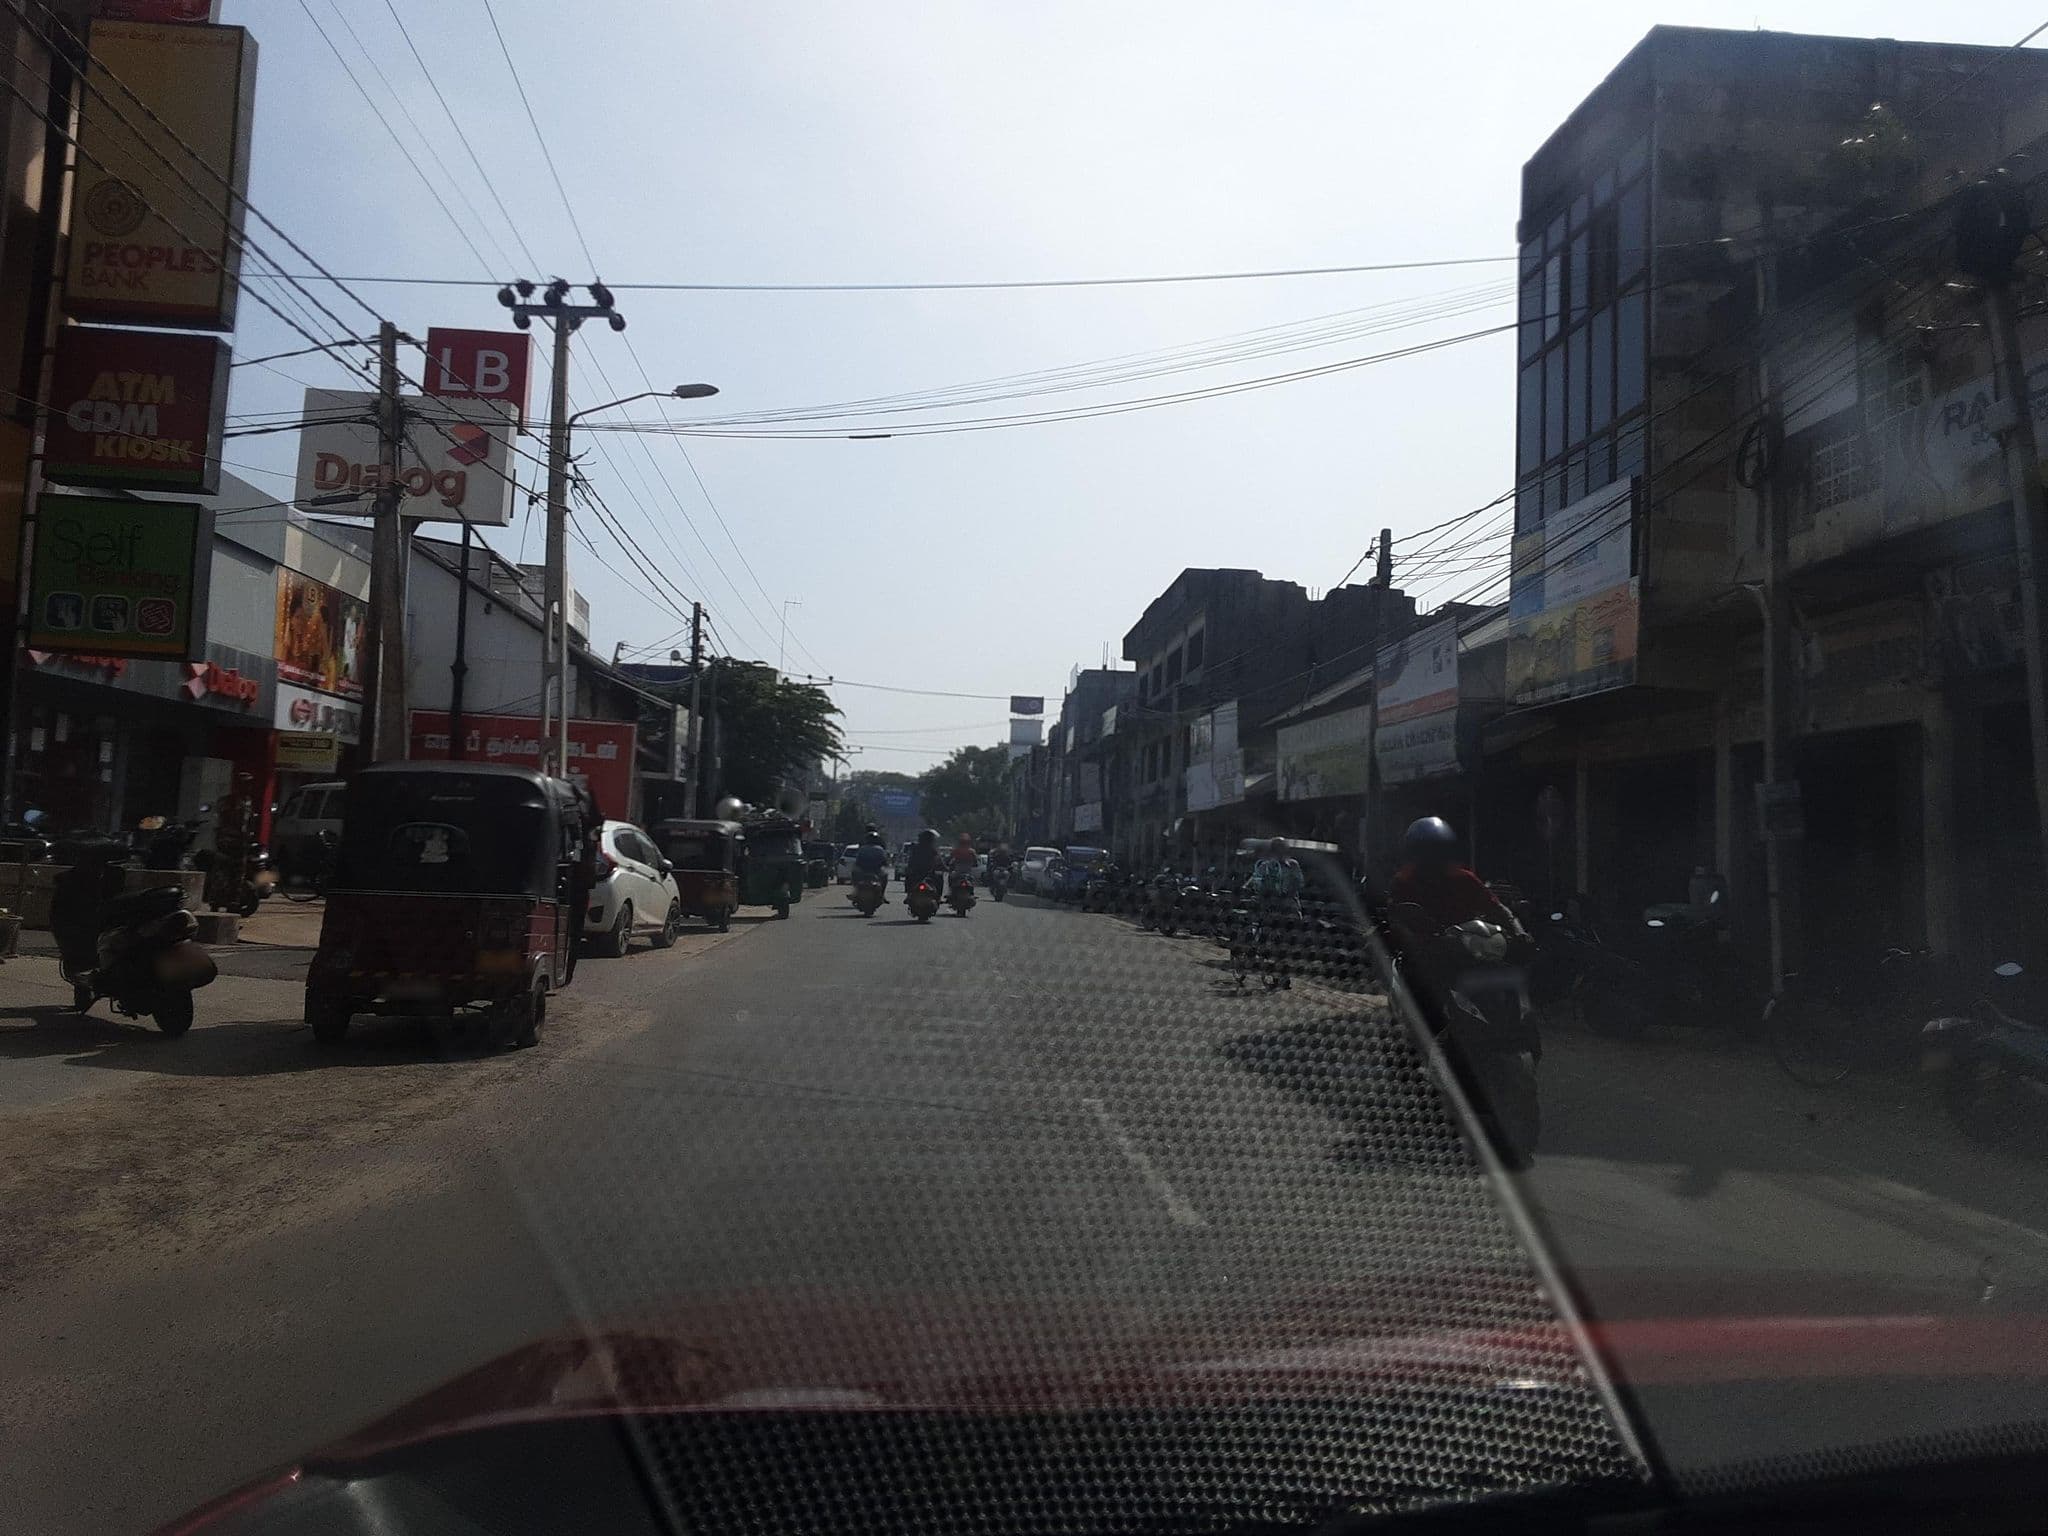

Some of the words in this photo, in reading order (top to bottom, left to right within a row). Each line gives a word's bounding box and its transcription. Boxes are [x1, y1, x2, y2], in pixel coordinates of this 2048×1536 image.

[81, 267, 149, 289] BANK
[88, 370, 175, 406] ATM
[66, 400, 158, 436] CDM
[95, 434, 192, 463] KIOSK
[314, 452, 466, 508] Diaog
[52, 519, 143, 569] Self
